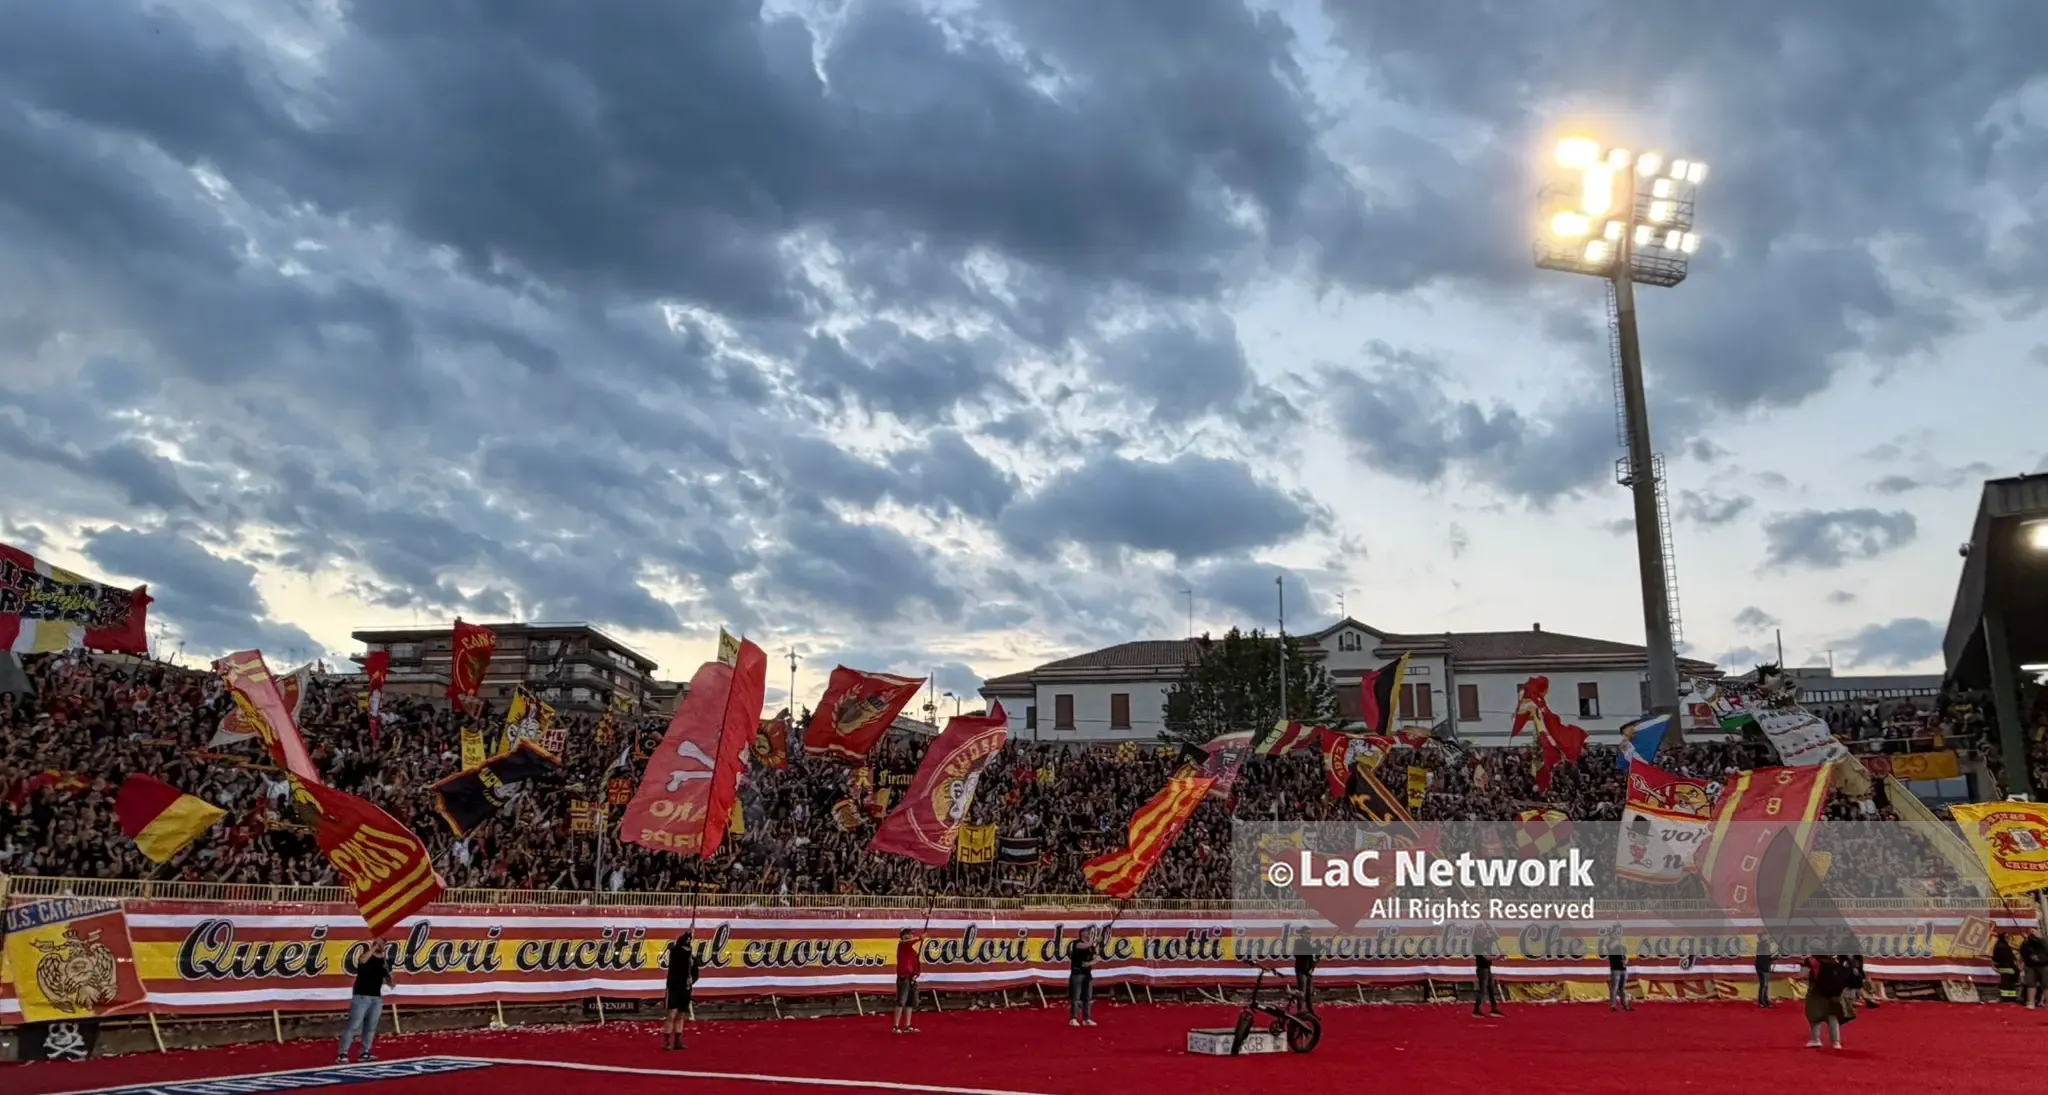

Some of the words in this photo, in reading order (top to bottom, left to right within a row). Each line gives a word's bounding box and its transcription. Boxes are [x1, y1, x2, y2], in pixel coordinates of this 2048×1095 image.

[968, 829, 987, 843] TI
[960, 847, 993, 861] AMO
[7, 906, 36, 931] U.S.
[176, 917, 328, 981] Quei
[514, 924, 647, 973] cuciti
[742, 937, 886, 968] cuore...
[923, 923, 1030, 965] colori
[1142, 926, 1226, 962] notti
[1519, 923, 1589, 960] Che
[1637, 935, 1743, 970] sogno
